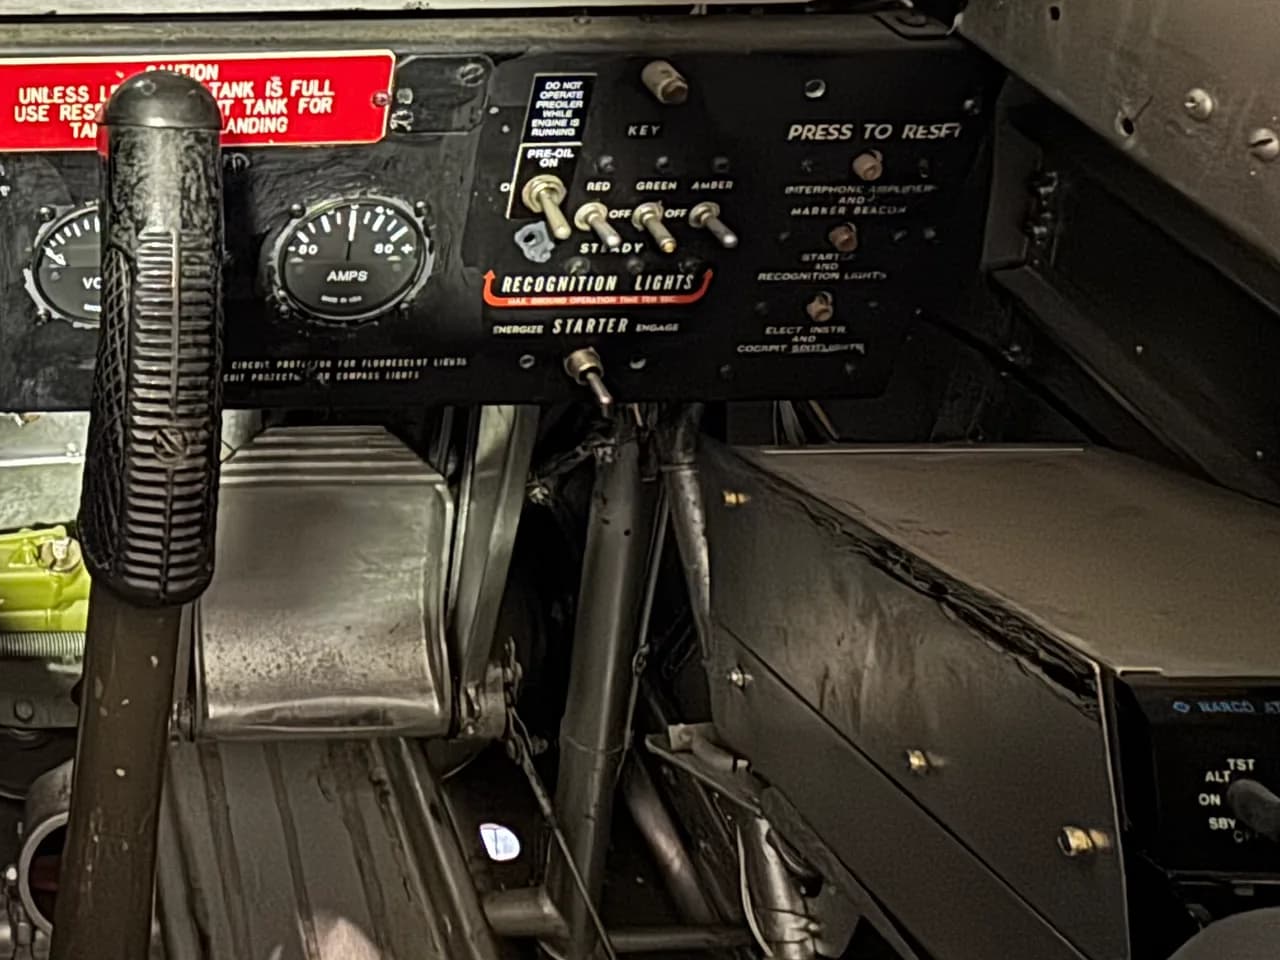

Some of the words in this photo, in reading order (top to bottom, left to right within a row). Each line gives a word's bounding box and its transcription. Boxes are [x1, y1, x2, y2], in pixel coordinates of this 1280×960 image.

[18, 85, 89, 104] UNLESS
[208, 81, 255, 98] TANK
[265, 81, 283, 98] IS
[290, 79, 336, 97] FULL
[545, 81, 561, 91] DO
[13, 105, 50, 123] USE
[242, 98, 288, 115] TANK
[298, 97, 333, 113] FOR
[627, 125, 661, 136] KEY
[787, 123, 854, 141] PRESS
[863, 123, 893, 139] TO
[526, 148, 575, 159] PRE-OIL
[539, 158, 559, 168] ON
[586, 181, 612, 192] RED
[636, 180, 678, 191] GREEN
[691, 180, 734, 190] AMBER
[608, 209, 633, 219] OFF
[664, 208, 688, 219] OFF
[790, 206, 847, 215] MARKER
[853, 205, 907, 215] BEACON
[326, 270, 369, 282] AMPS
[757, 271, 840, 281] RECOGNITION
[501, 275, 618, 293] RECOGNITION
[633, 274, 696, 291] LIGHTS
[492, 325, 545, 334] ENERGIZE
[551, 317, 630, 335] STARTER
[634, 323, 681, 333] ENGAGE
[1227, 758, 1256, 771] TST
[1205, 770, 1231, 783] ALT
[1198, 793, 1221, 806] ON
[1208, 817, 1236, 830] SBY
